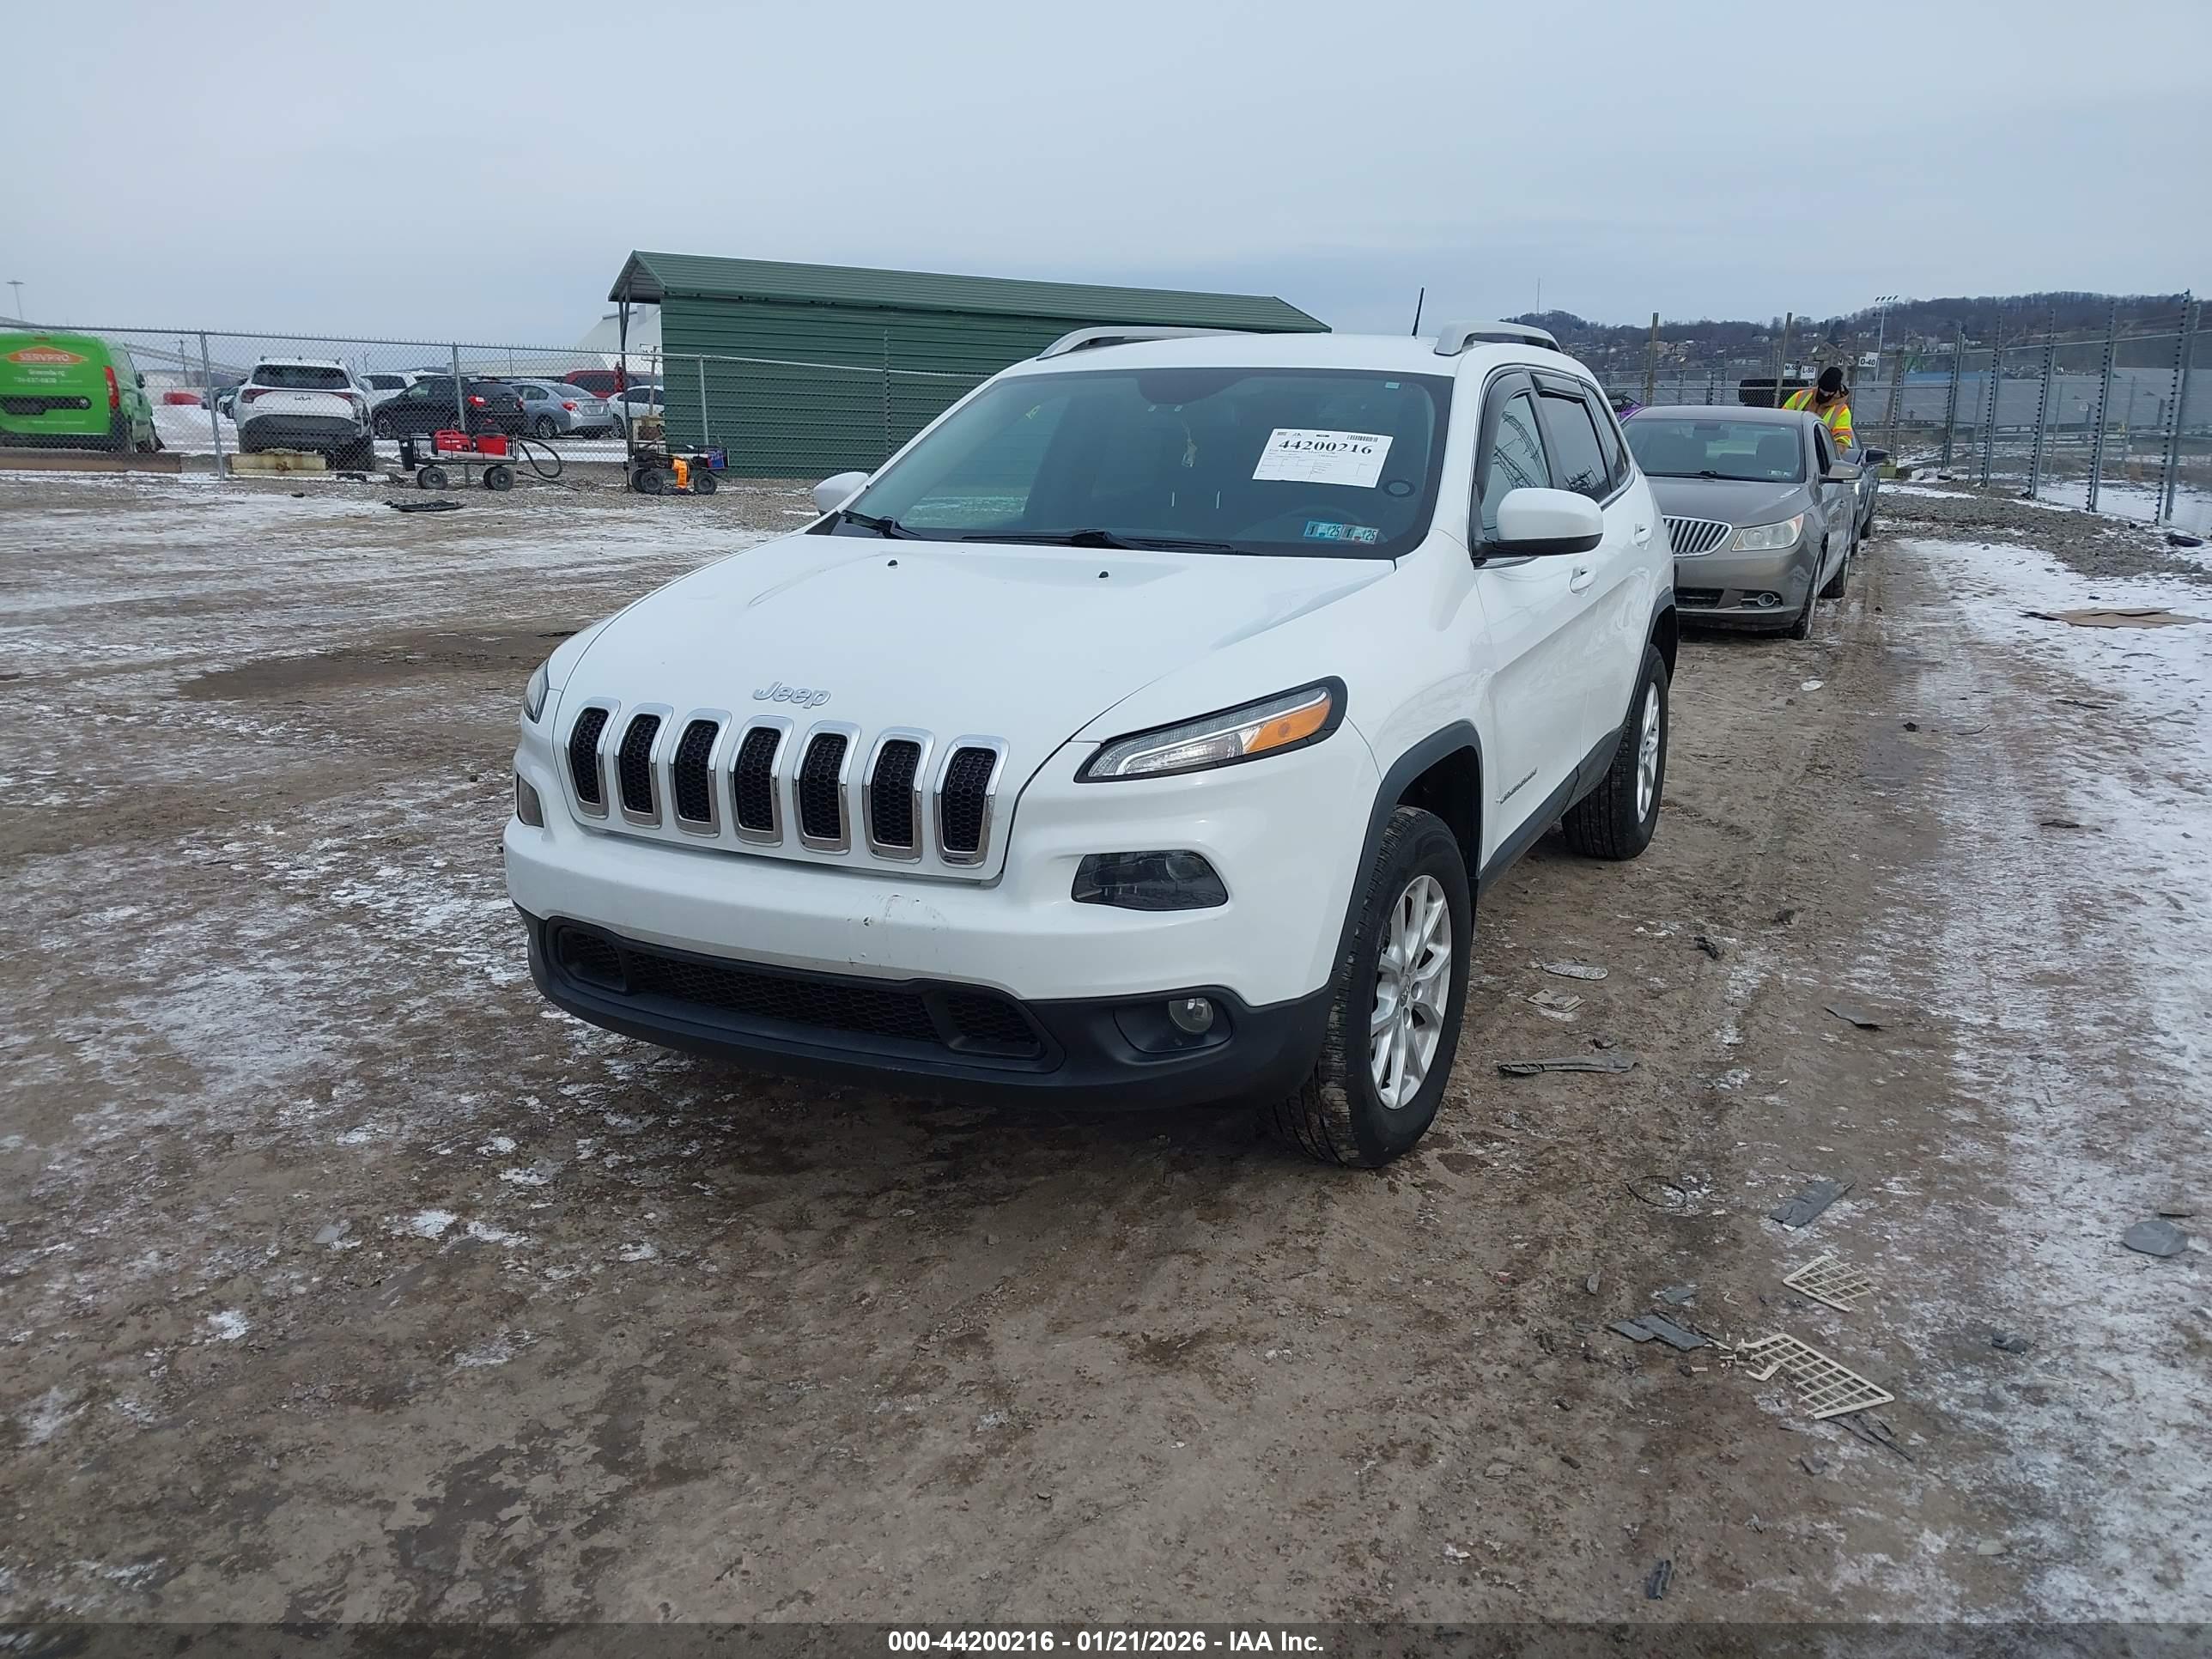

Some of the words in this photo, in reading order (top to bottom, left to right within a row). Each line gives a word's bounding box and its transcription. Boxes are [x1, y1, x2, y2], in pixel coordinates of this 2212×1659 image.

[18, 353, 70, 362] SERVPRO
[1278, 439, 1373, 455] 44200216
[752, 680, 831, 709] Jeep
